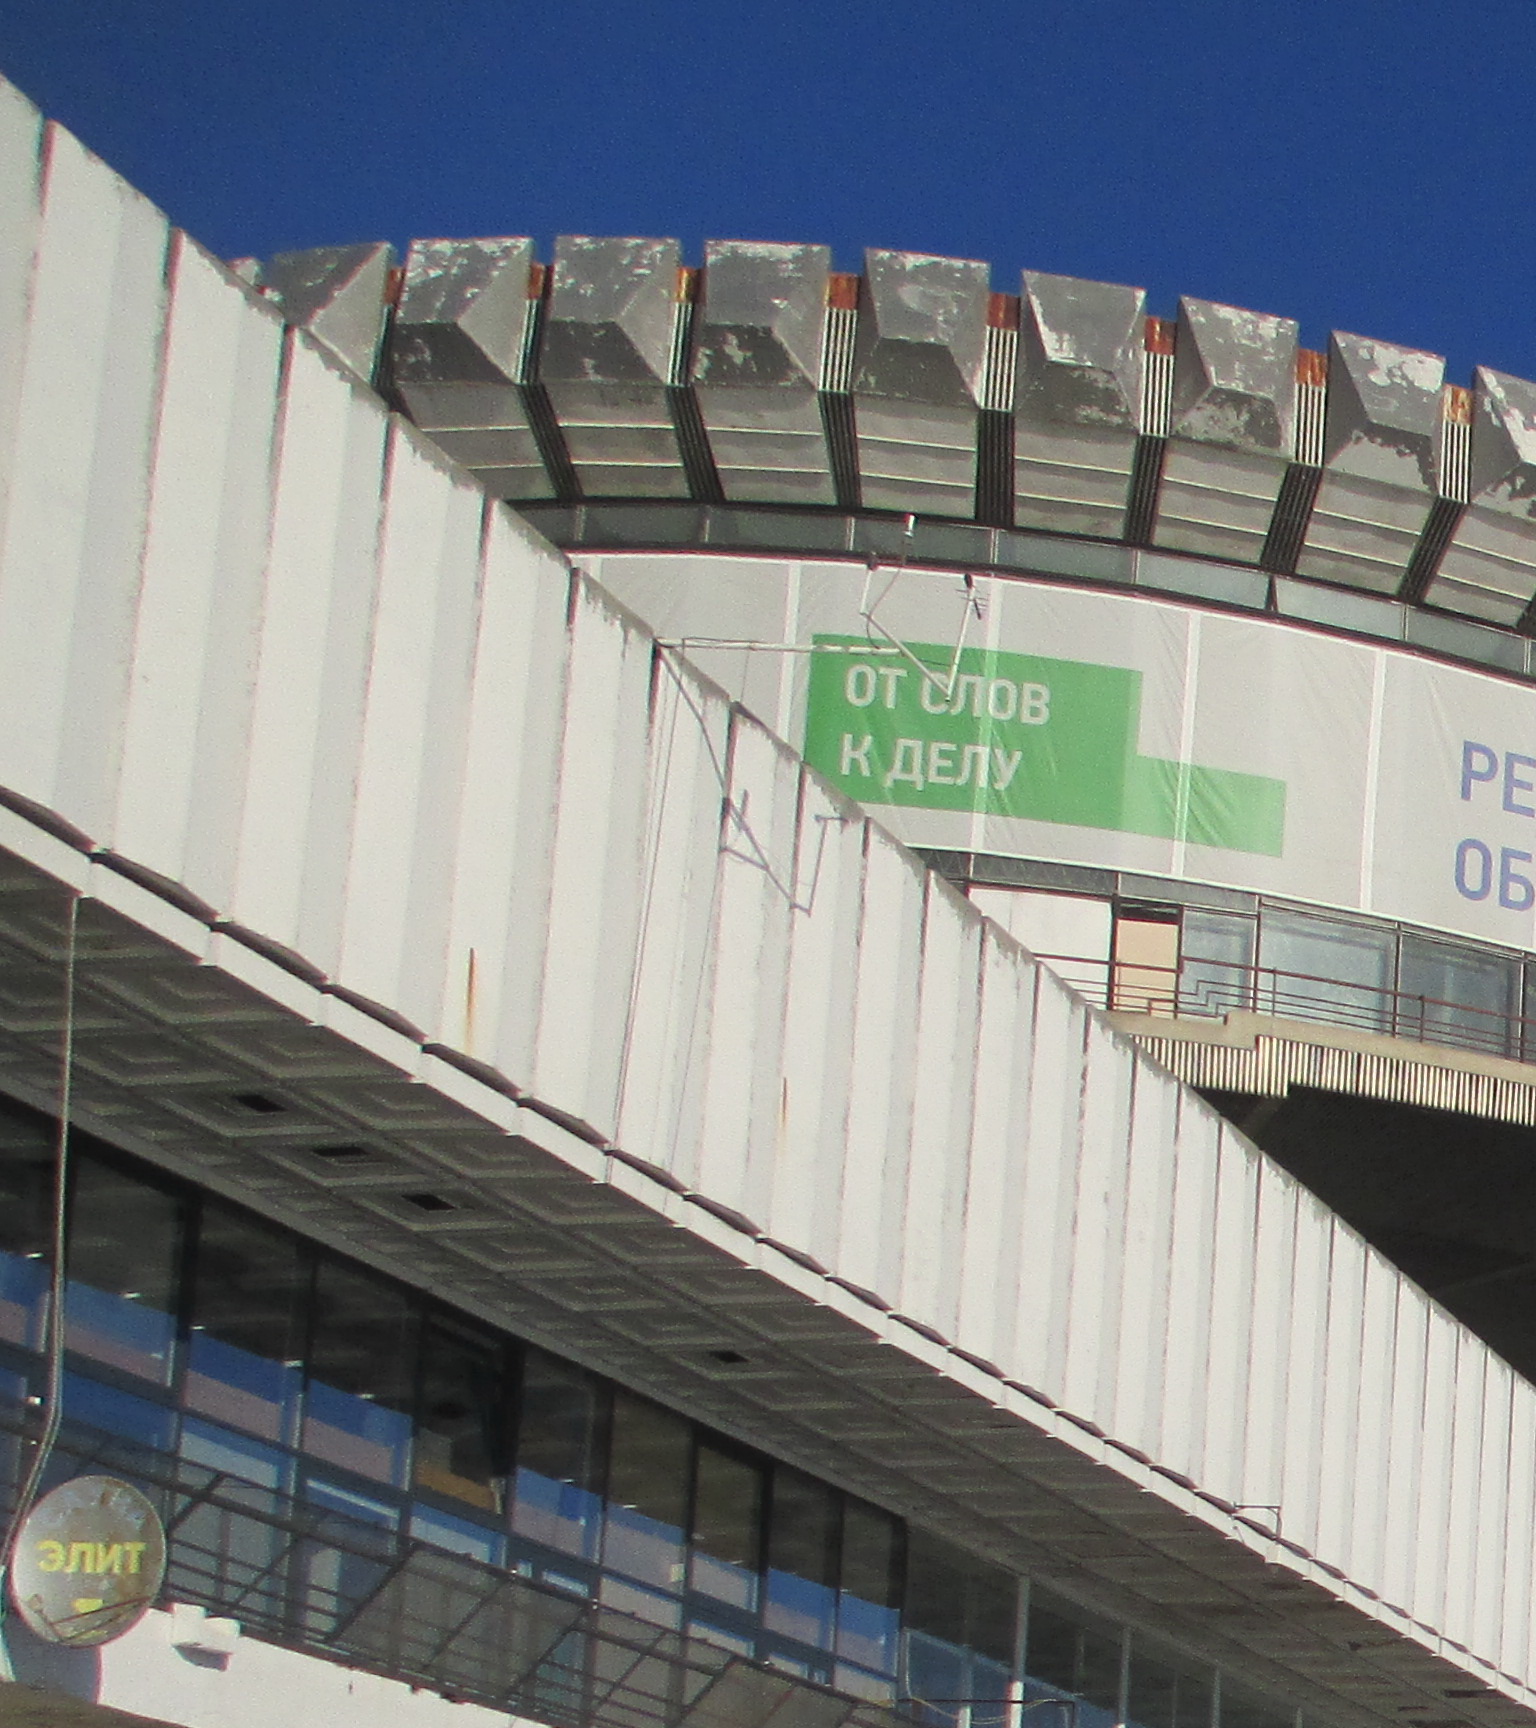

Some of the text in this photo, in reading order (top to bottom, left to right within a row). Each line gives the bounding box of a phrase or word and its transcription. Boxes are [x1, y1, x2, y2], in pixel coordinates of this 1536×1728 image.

[846, 664, 1050, 725] ОТ СЛОВ
[841, 733, 1023, 791] К ДЕЛУ
[36, 1540, 146, 1574] ЭЛИТ
